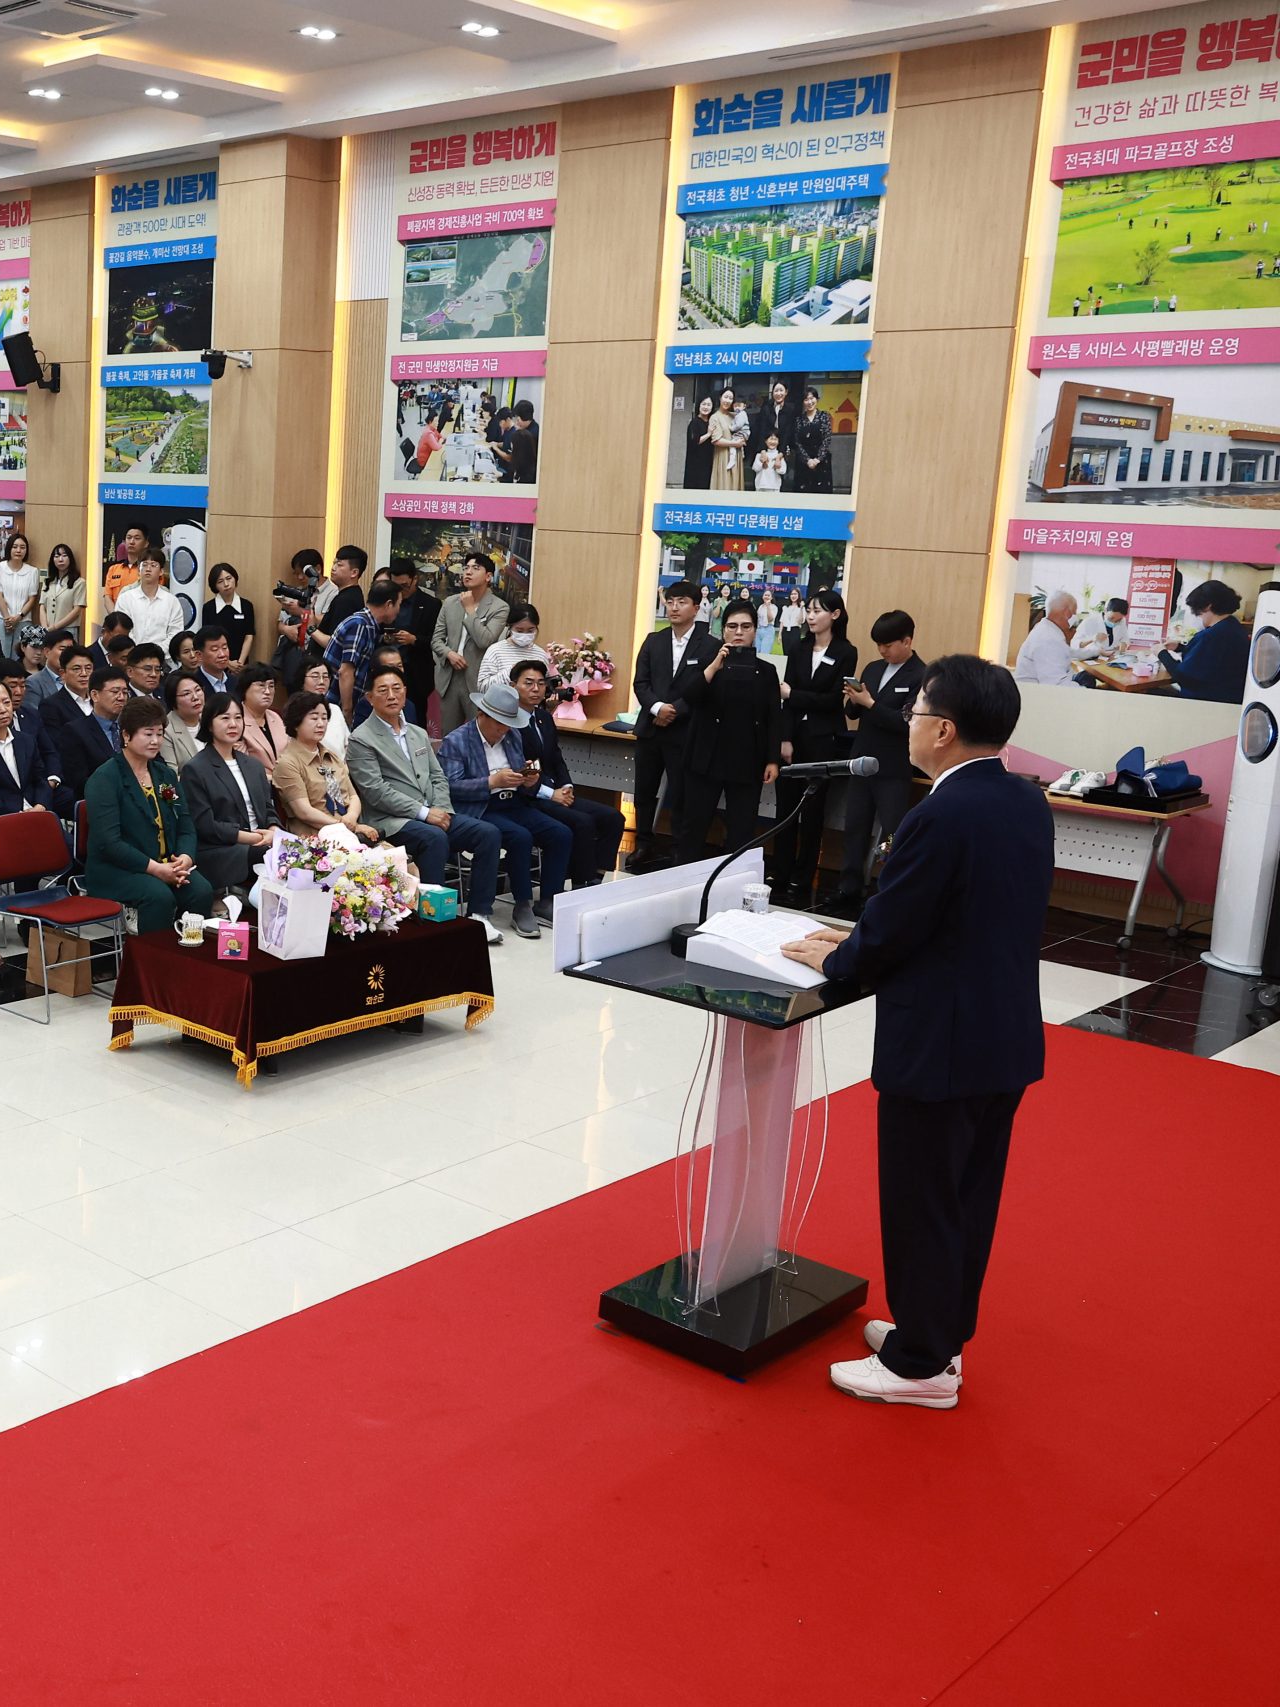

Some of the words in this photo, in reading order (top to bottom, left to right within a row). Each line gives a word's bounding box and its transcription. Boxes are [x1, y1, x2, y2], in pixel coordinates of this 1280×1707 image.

[1077, 28, 1187, 88] 군민을
[1196, 14, 1280, 72] 행복
[692, 88, 784, 136] 화순을
[791, 73, 890, 124] 새롭게
[1074, 100, 1132, 128] 건강한
[1138, 94, 1179, 119] 삶과
[1185, 84, 1250, 114] 따뜻한
[1259, 80, 1278, 102] 복
[409, 134, 466, 174] 군민을
[472, 122, 556, 166] 행복하게
[691, 146, 757, 170] 대한민국의
[762, 140, 802, 161] 혁신이
[806, 139, 820, 156] 된
[824, 131, 884, 155] 인구정책
[1064, 147, 1120, 170] 전국최대
[1124, 138, 1198, 163] 파크골프장
[1202, 134, 1234, 154] 조성
[111, 180, 159, 213] 화순을
[164, 172, 216, 206] 새롭게
[408, 185, 434, 203] 신성장
[436, 183, 454, 200] 동력
[457, 181, 478, 196] 확보,
[480, 176, 510, 194] 든든한
[512, 173, 531, 190] 민생
[534, 170, 554, 188] 지원
[686, 188, 725, 206] 전국최초
[802, 174, 869, 195] 만원임대주택
[118, 222, 140, 236] 관광객
[142, 218, 168, 233] 500만
[170, 216, 186, 229] 시대
[188, 213, 206, 228] 도약!
[407, 219, 436, 232] 폐광지역
[438, 214, 482, 230] 경제진흥사업
[484, 211, 500, 224] 국비
[503, 208, 525, 222] 700억
[528, 208, 544, 220] 확보
[191, 243, 204, 254] 조성
[674, 352, 712, 366] 전남최초
[716, 351, 738, 366] 24시
[742, 350, 784, 366] 어린이집
[1041, 342, 1081, 360] 원스톱
[1085, 341, 1126, 358] 서비스
[1131, 338, 1204, 358] 사평빨래방
[1208, 338, 1240, 356] 운영
[398, 362, 406, 374] 전
[408, 362, 422, 373] 군민
[426, 360, 479, 373] 민생안정지원금
[482, 358, 498, 370] 지급
[104, 488, 116, 499] 남산
[135, 490, 146, 500] 조성
[392, 500, 420, 512] 소상공인
[423, 500, 438, 512] 지원
[440, 501, 456, 514] 정책
[460, 502, 474, 514] 강화
[664, 510, 702, 525] 전국최초
[706, 512, 734, 527] 자국민
[738, 514, 779, 530] 다문화팀
[782, 516, 804, 531] 신설
[1023, 528, 1101, 547] 마을주치의제
[1106, 531, 1134, 549] 운영
